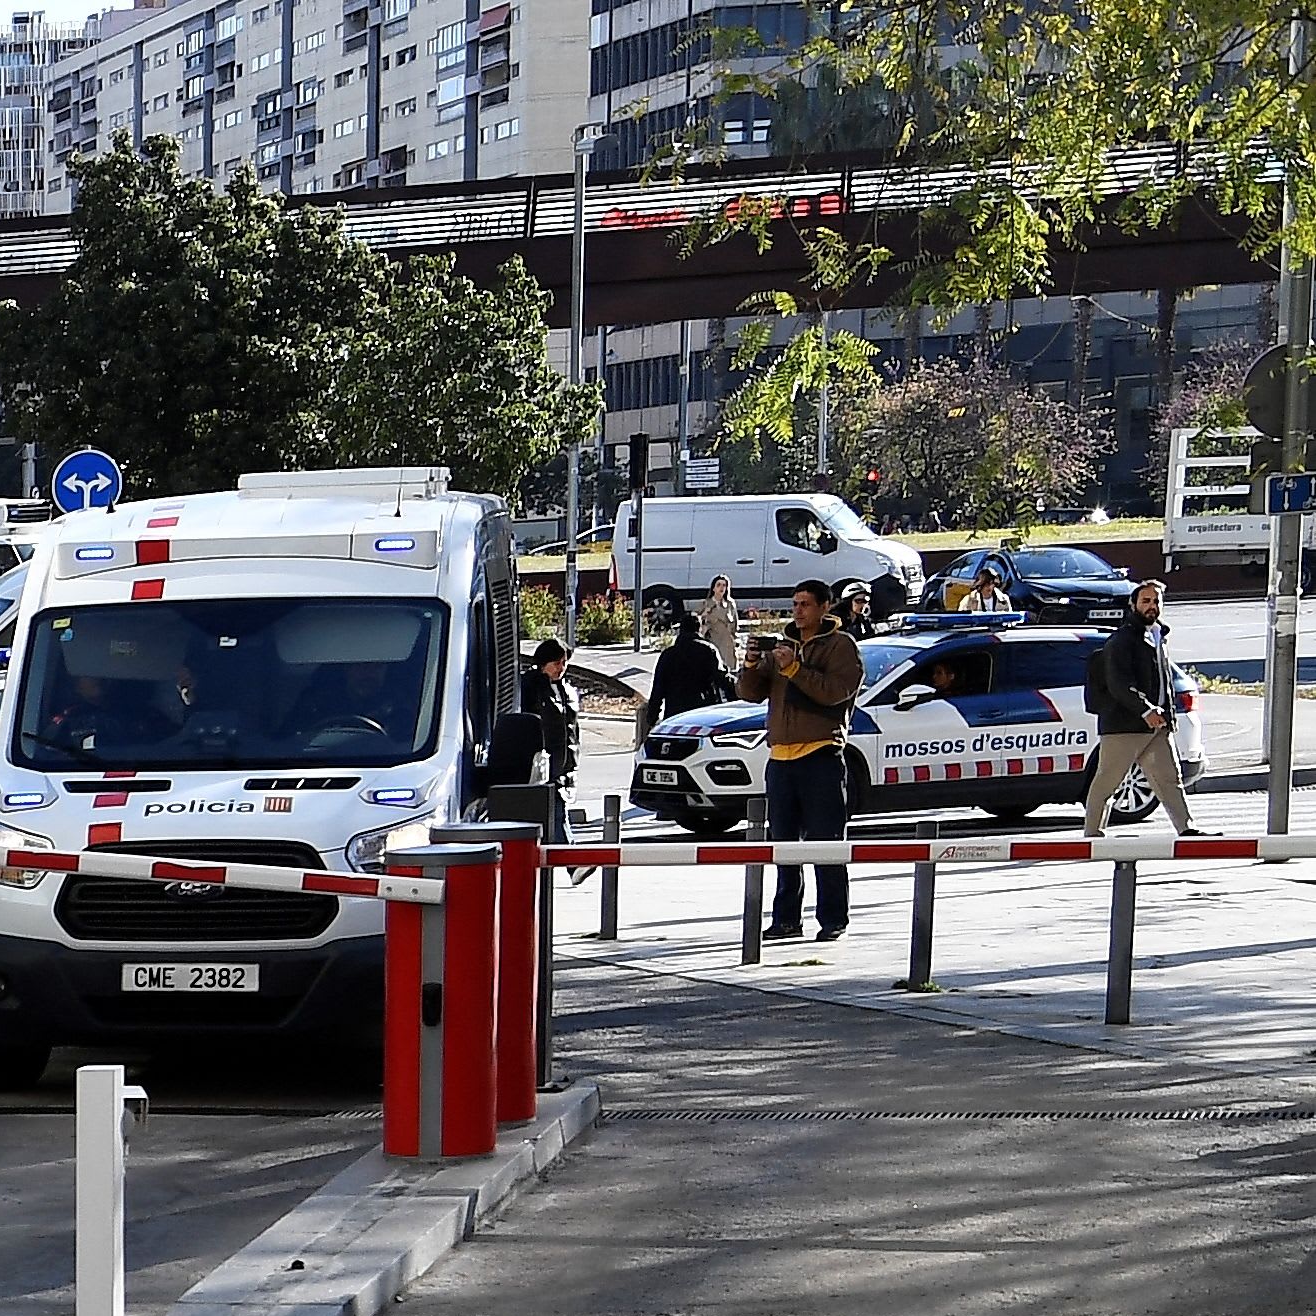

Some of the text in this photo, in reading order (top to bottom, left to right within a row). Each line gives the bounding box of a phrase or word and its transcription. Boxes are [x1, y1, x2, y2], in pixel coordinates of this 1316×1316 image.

[1187, 522, 1242, 534] arquitectura
[884, 728, 1089, 758] mossos d'esquadra
[143, 799, 256, 817] policia
[134, 967, 246, 989] CME 2382
